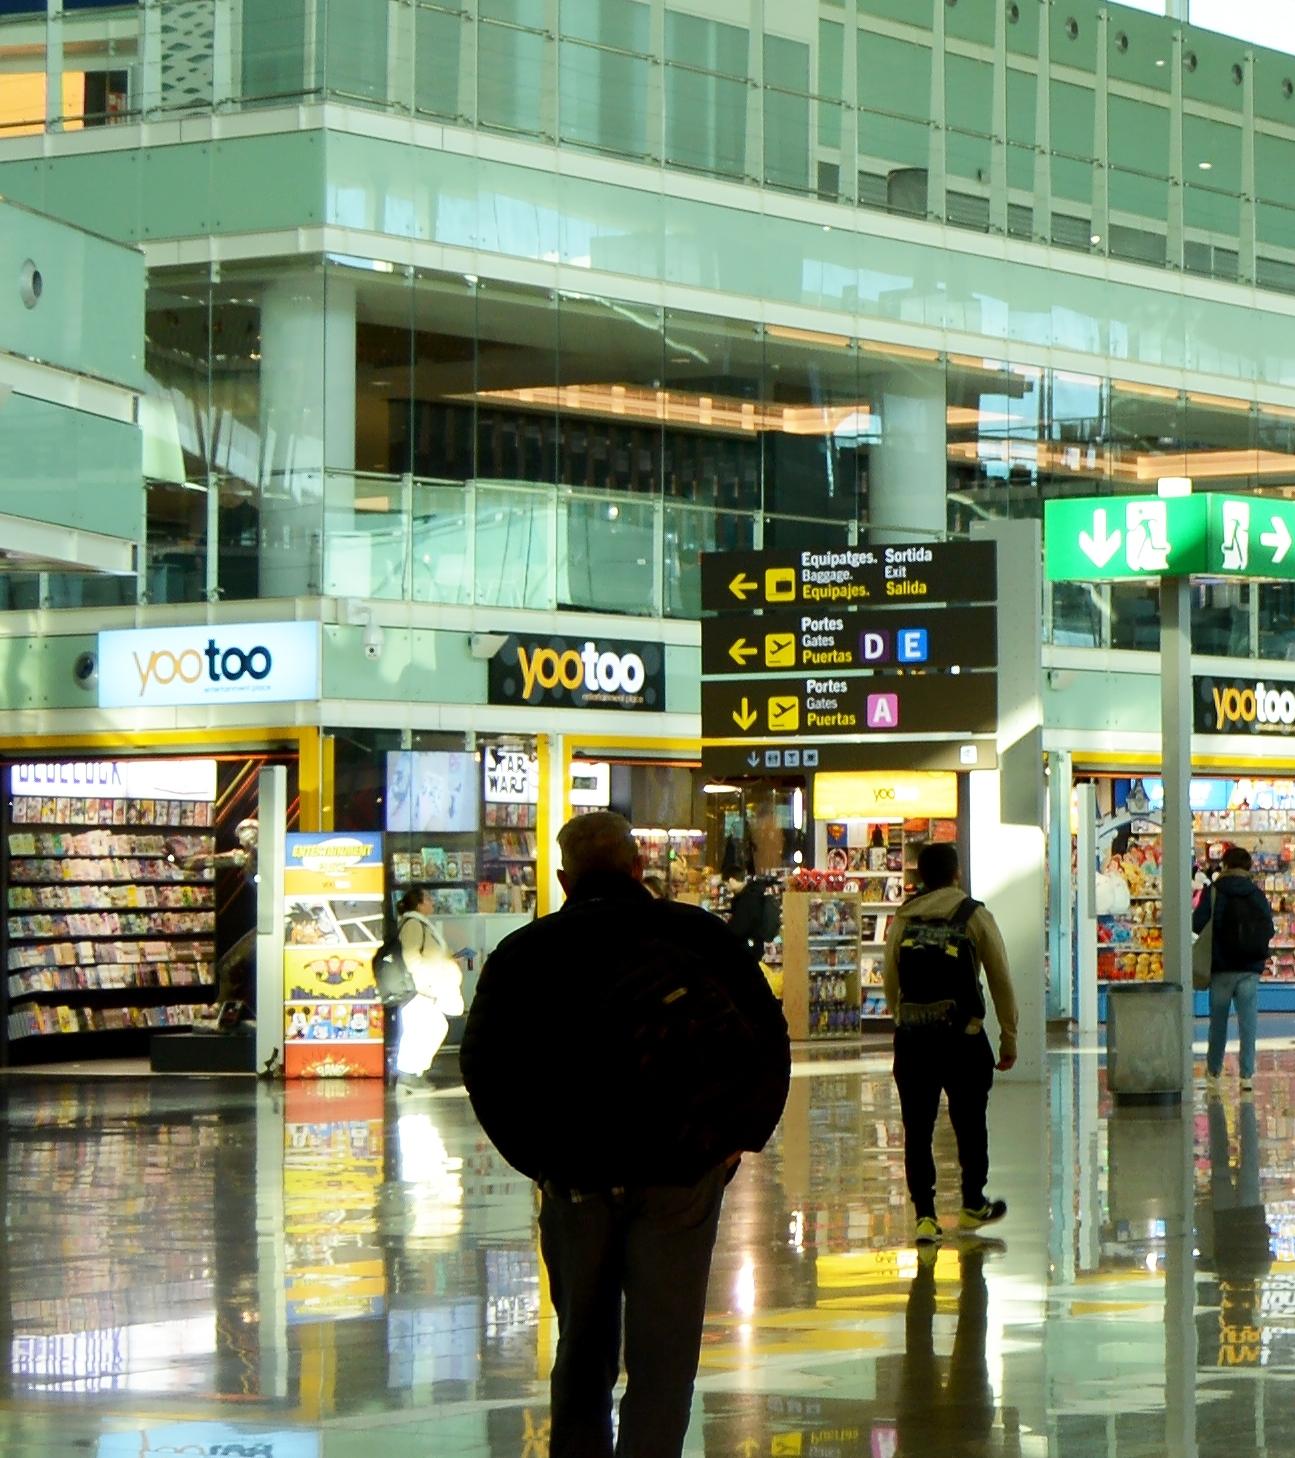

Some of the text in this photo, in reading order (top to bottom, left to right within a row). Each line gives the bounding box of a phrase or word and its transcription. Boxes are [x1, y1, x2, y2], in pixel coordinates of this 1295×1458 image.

[801, 547, 933, 568] Equipatges. Sortida
[801, 565, 907, 583] Baggage. Exit
[802, 580, 927, 600] Equipajes. Salida
[801, 616, 844, 632] Portes
[802, 634, 835, 648] Gates
[864, 631, 922, 660] D E
[802, 649, 852, 664] Puertas
[133, 638, 272, 697] yootoo
[517, 641, 645, 699] yootoo
[806, 679, 848, 694] Portes
[806, 697, 838, 710] Gates
[872, 698, 893, 723] A
[807, 712, 856, 727] Puertas
[488, 775, 527, 794] WARS
